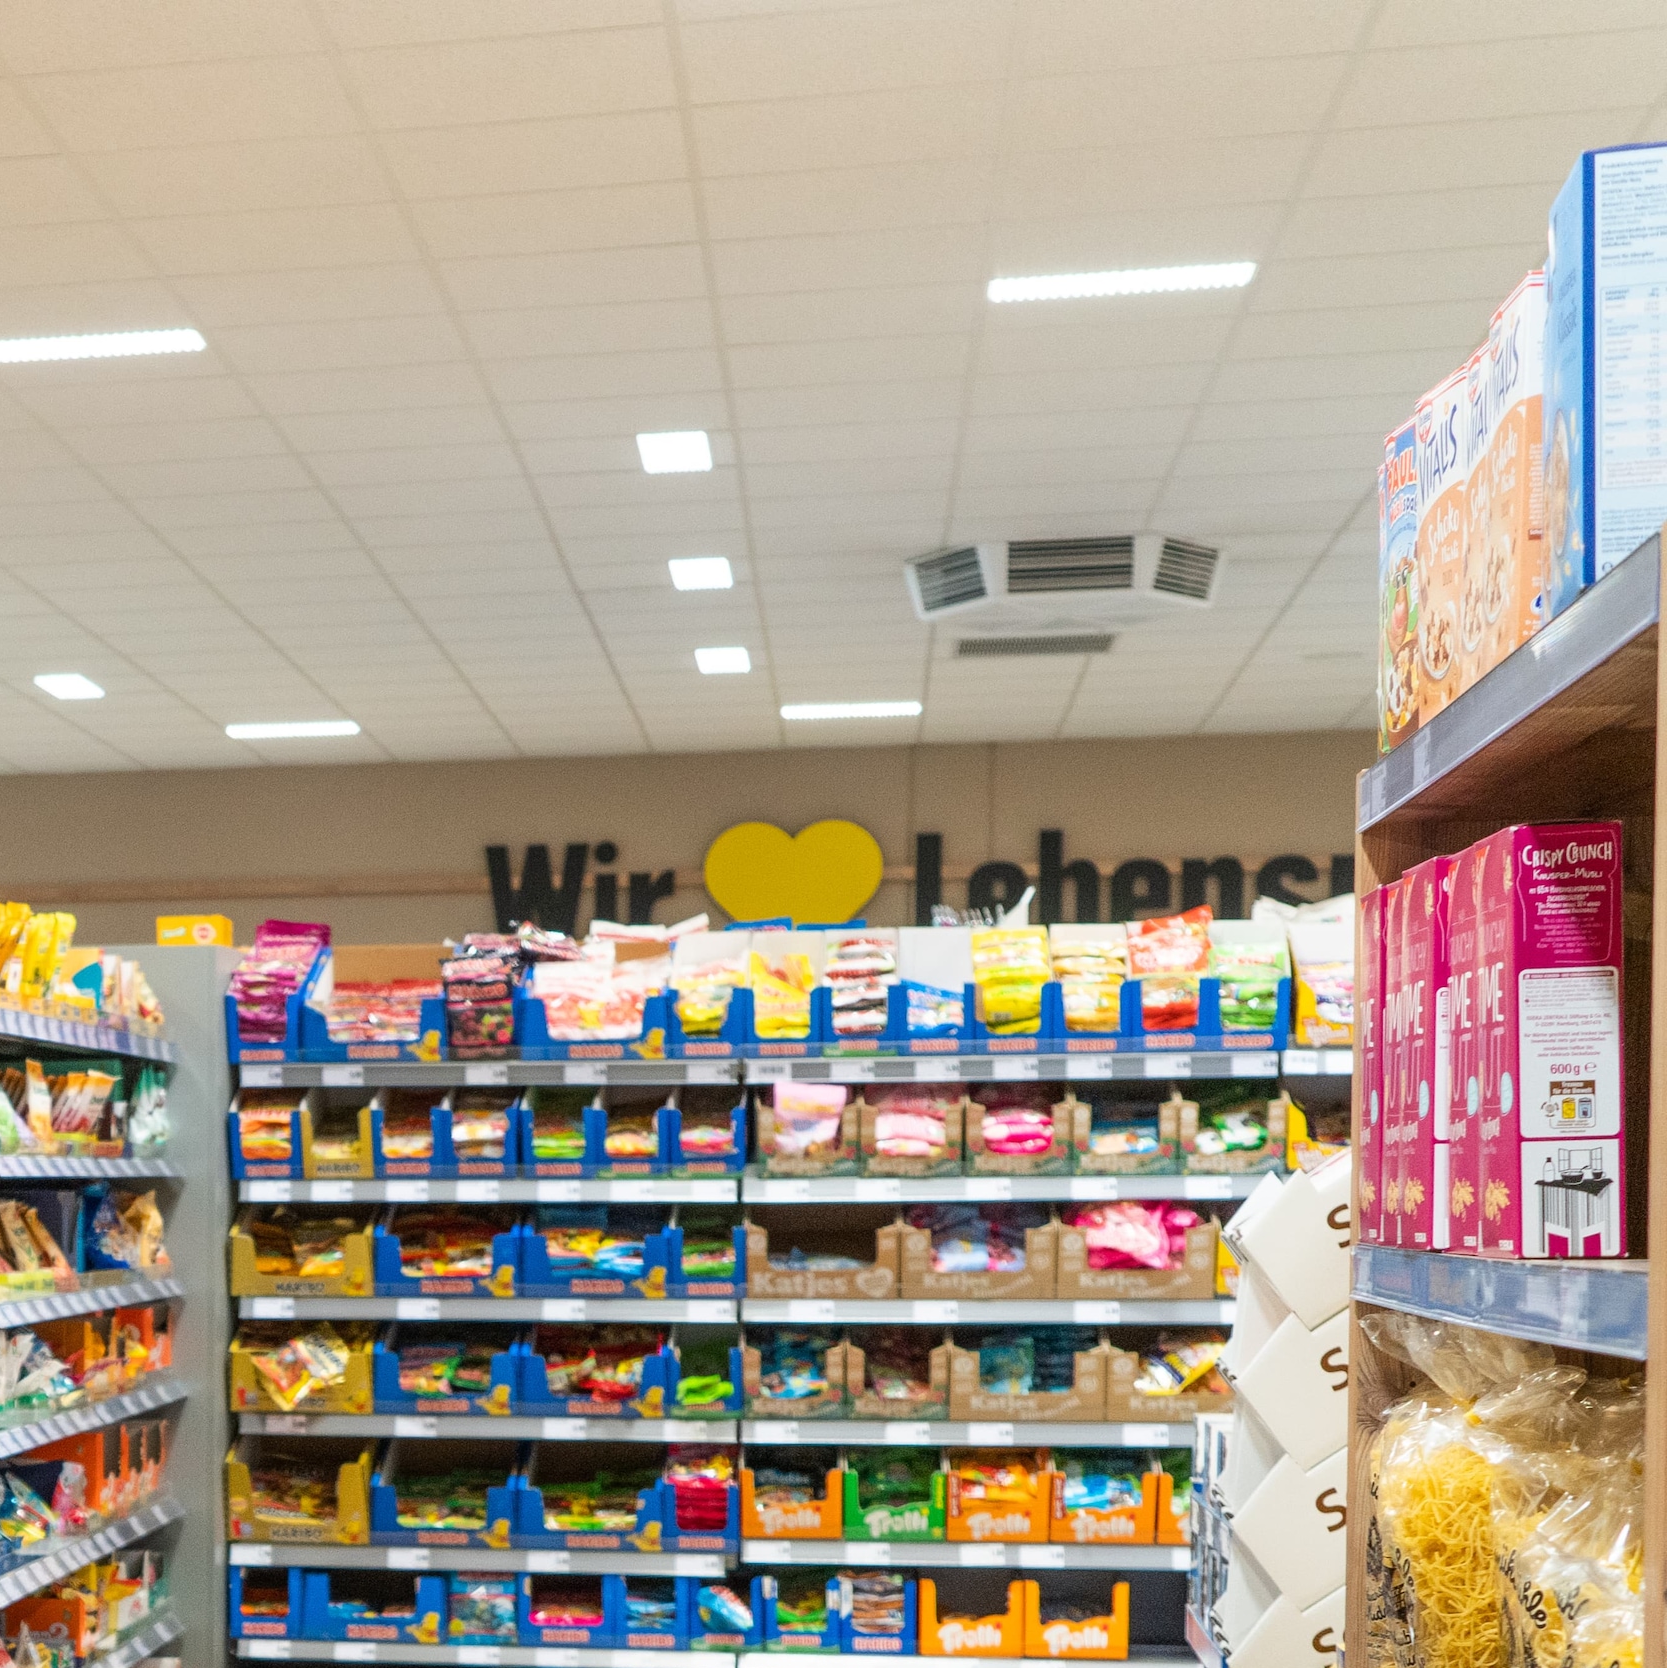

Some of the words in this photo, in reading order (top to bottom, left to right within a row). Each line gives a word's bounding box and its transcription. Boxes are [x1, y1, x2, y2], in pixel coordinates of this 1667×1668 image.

[1416, 404, 1458, 504] VITALIS
[1523, 845, 1563, 867] CRISPY
[1566, 842, 1612, 863] CRUNCH
[484, 841, 675, 934] Wir
[1550, 1064, 1572, 1074] 600
[863, 1511, 929, 1538] Trolli
[966, 1511, 1030, 1538] Trolli
[1071, 1513, 1135, 1541] Trolli
[937, 1622, 1002, 1653] Trolli
[1043, 1624, 1108, 1655] Trolli
